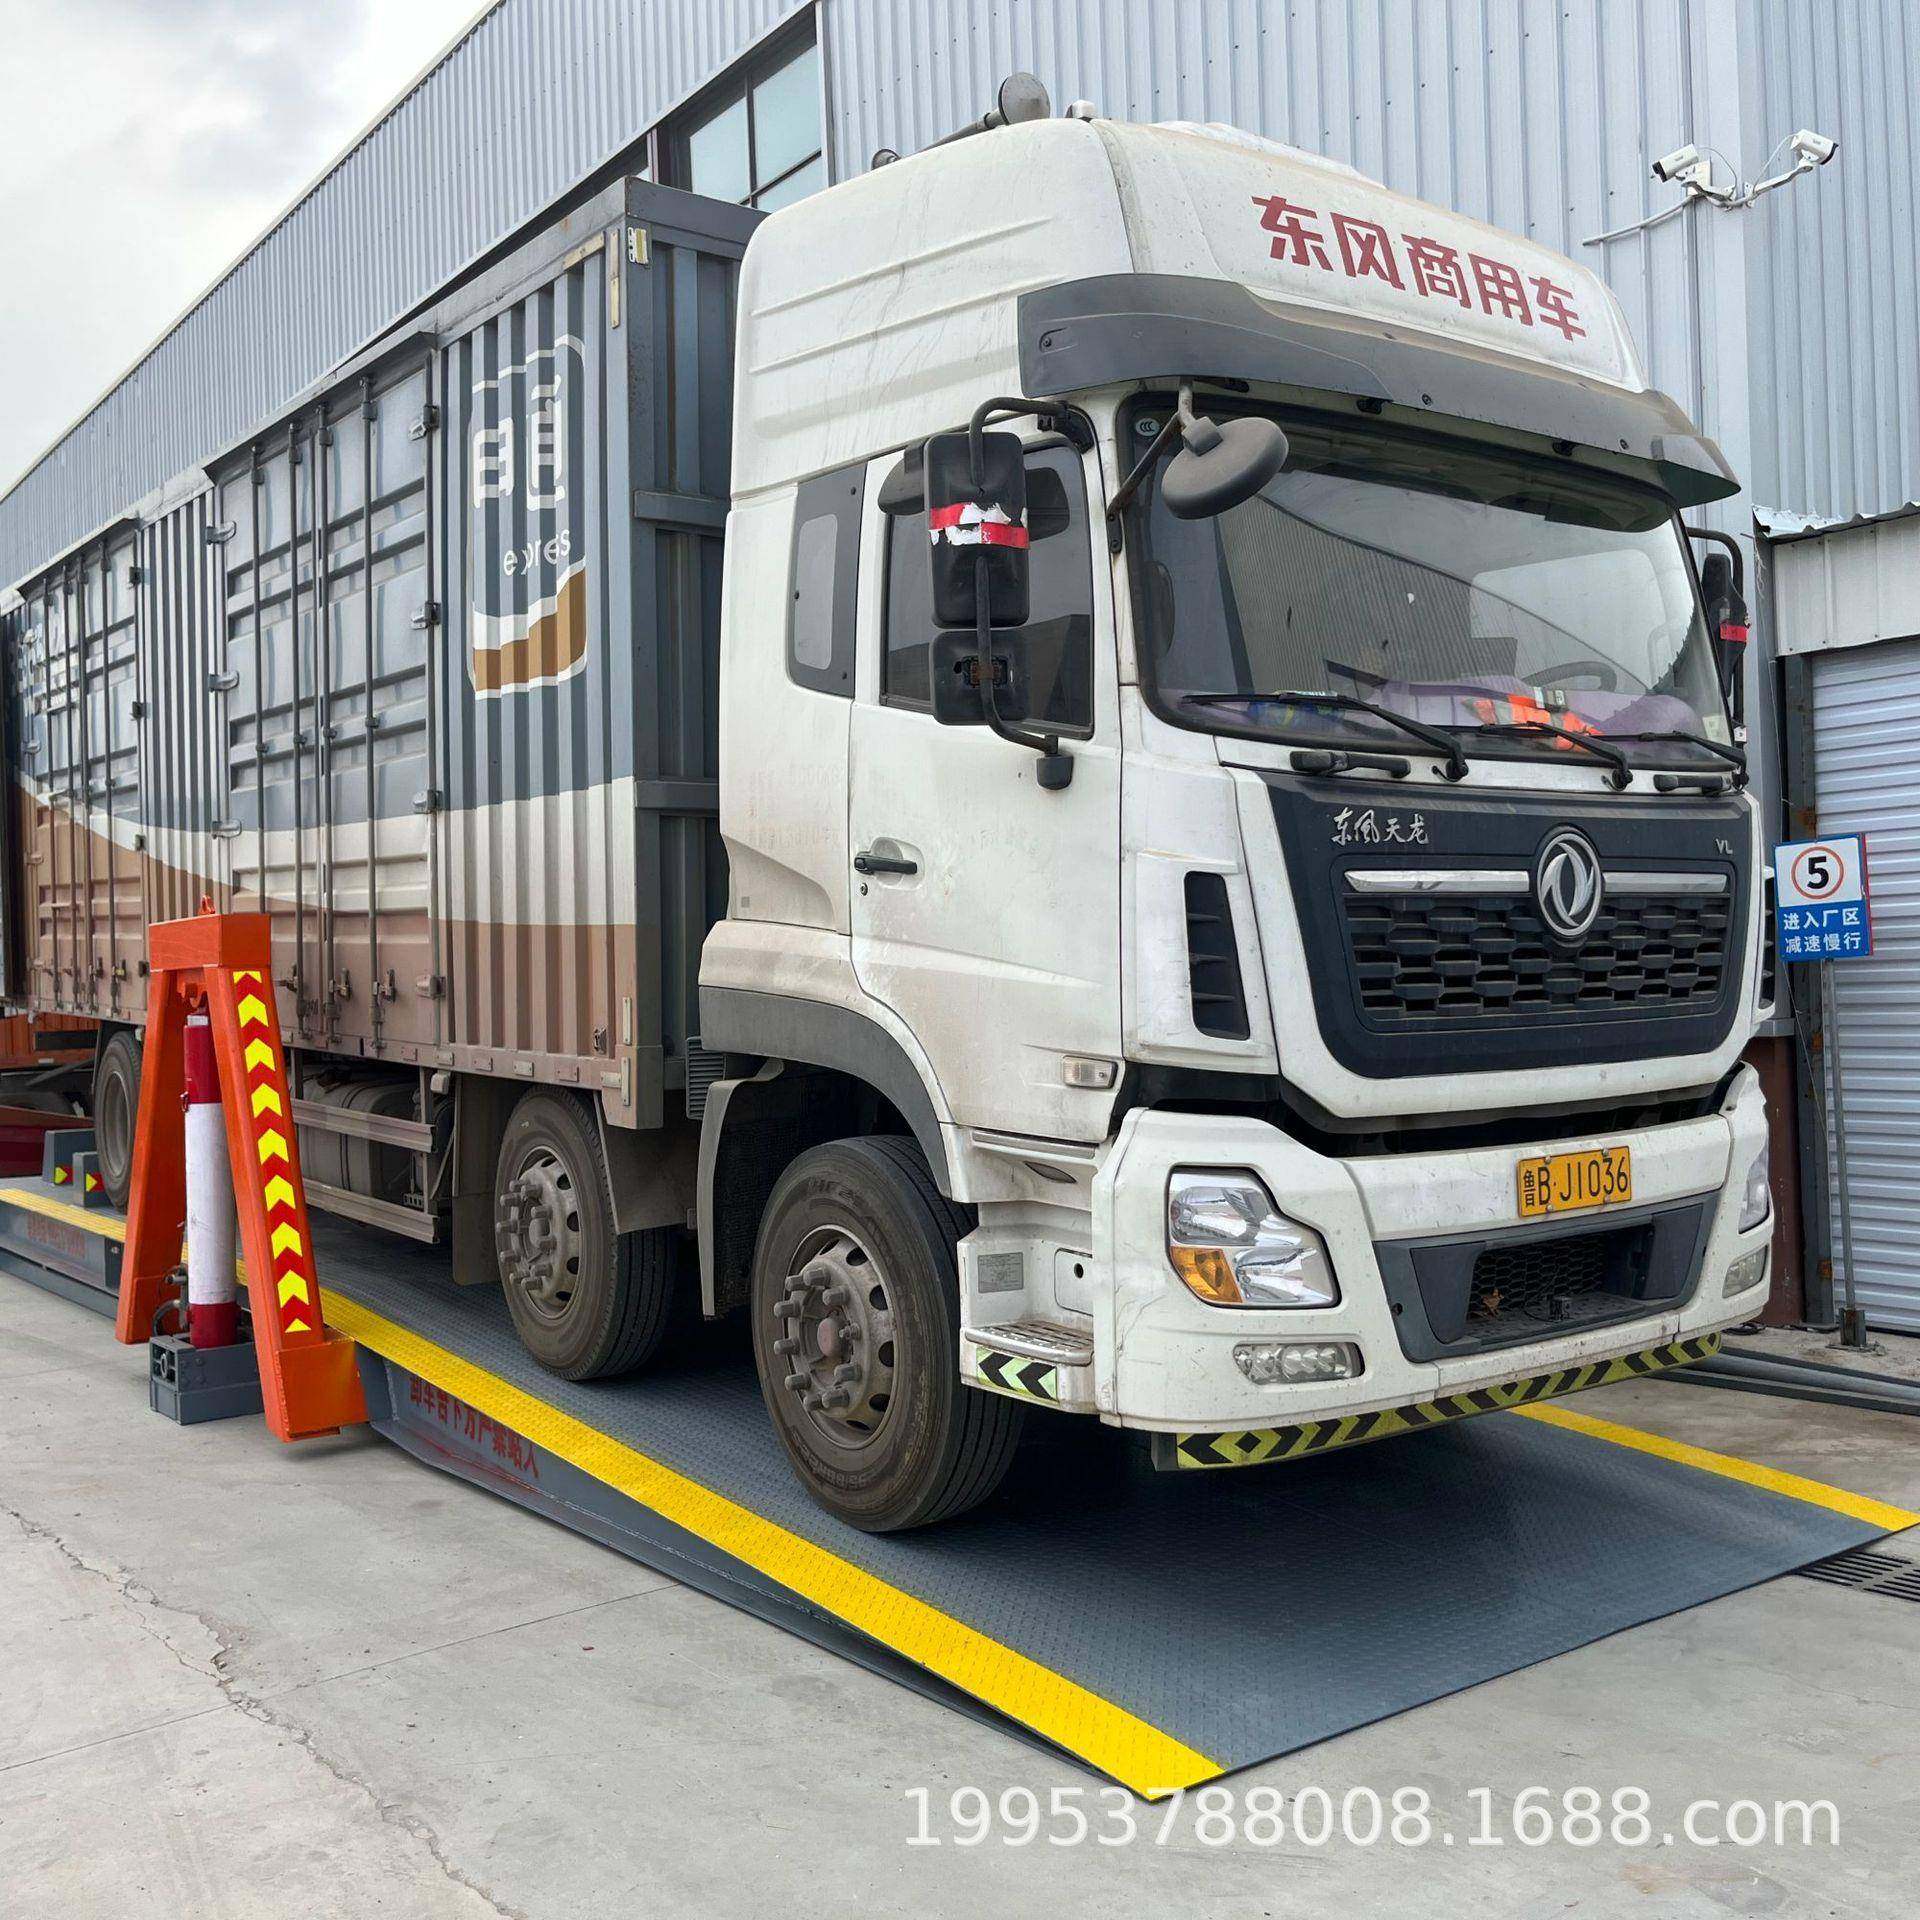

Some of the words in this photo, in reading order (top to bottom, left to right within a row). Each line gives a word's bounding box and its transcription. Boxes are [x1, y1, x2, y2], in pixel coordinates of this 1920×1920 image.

[1251, 195, 1587, 342] 东风商用车
[1806, 855, 1830, 890] 5
[1783, 907, 1861, 931] 进入厂区
[1784, 932, 1862, 954] 减速慢行
